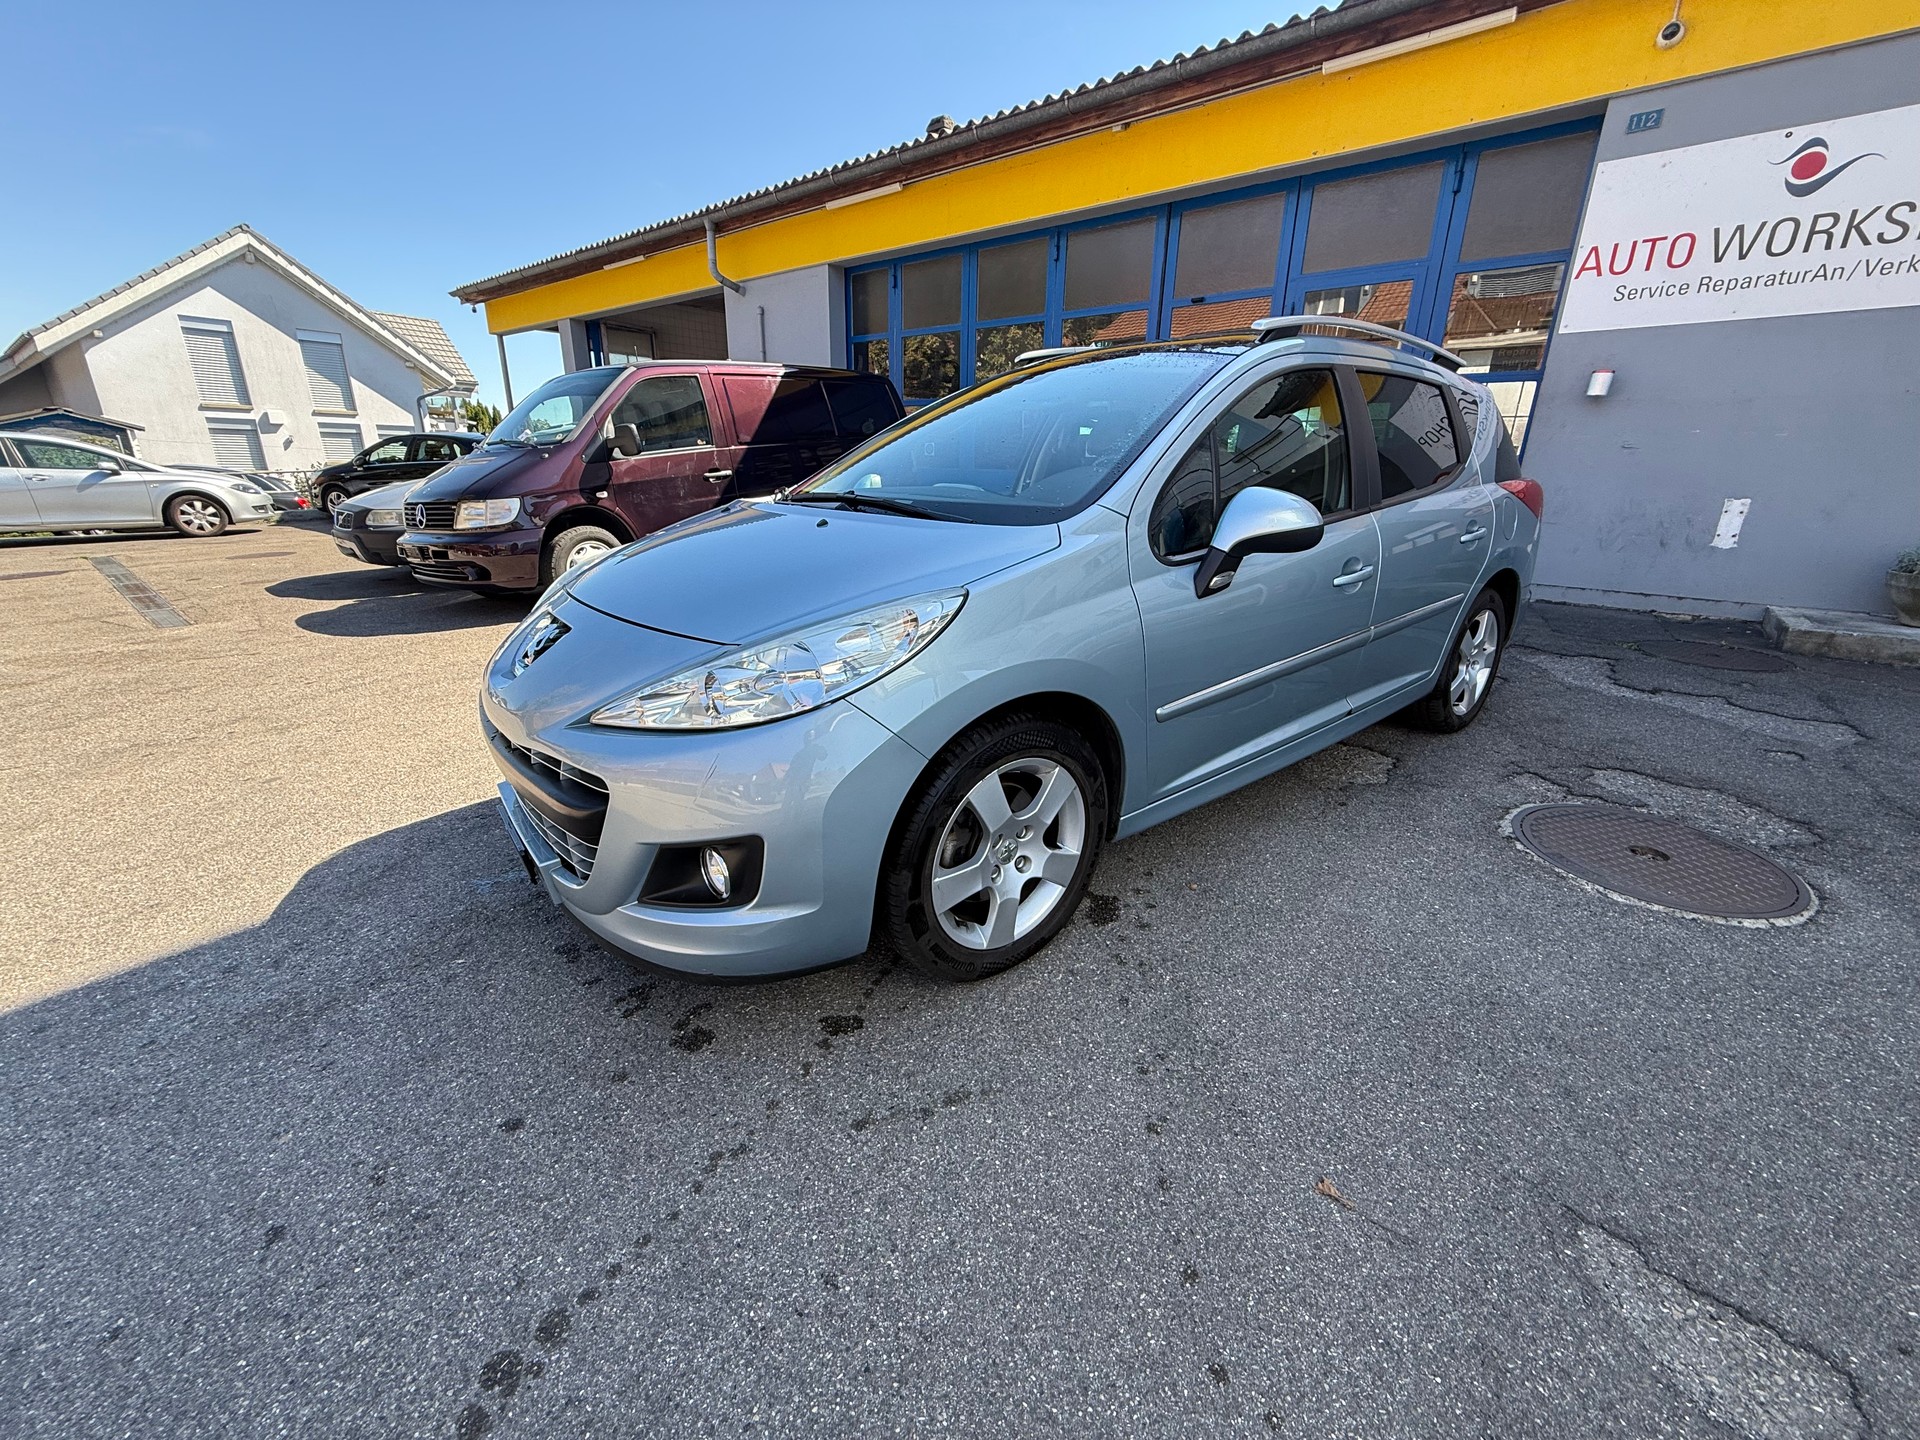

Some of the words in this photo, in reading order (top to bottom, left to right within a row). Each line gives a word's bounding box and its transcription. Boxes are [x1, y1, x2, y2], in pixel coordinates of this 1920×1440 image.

[1631, 112, 1657, 130] 112
[1573, 232, 1697, 280] AUTO
[1713, 201, 1920, 264] WORKS
[1613, 280, 1690, 302] Service
